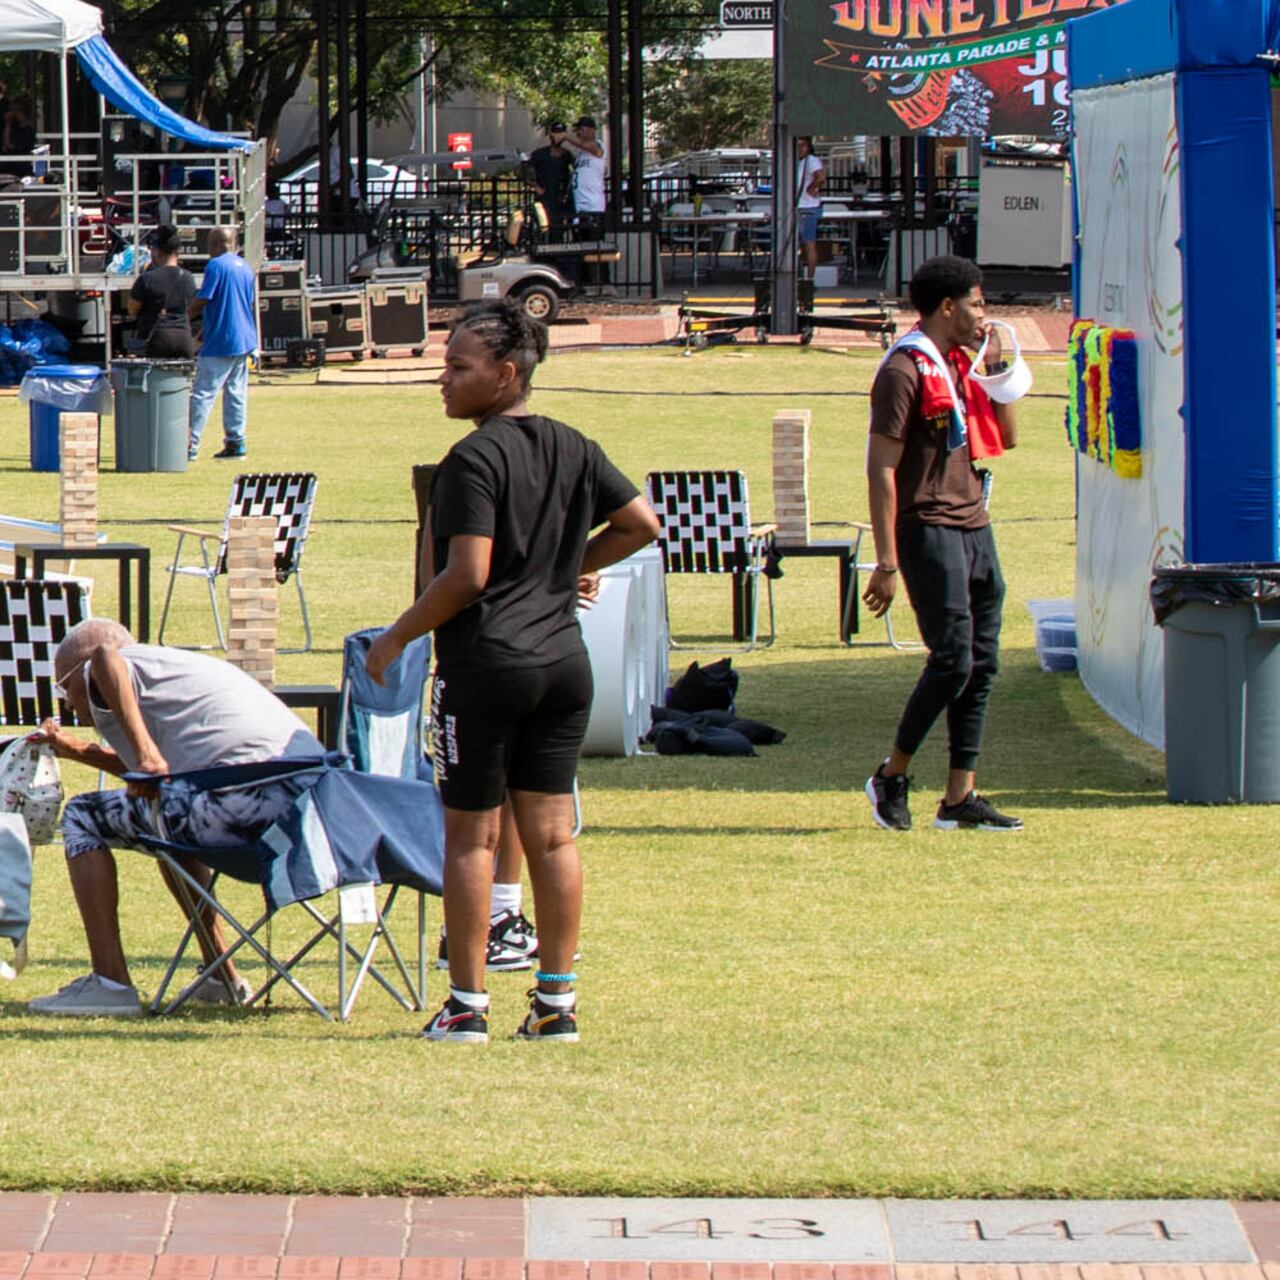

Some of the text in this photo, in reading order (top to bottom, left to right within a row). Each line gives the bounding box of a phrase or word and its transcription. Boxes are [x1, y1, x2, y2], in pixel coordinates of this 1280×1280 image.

[725, 7, 771, 20] NORTH
[866, 51, 951, 69] ATLANTA
[957, 36, 1030, 62] PARADE
[1035, 31, 1049, 46] &
[1004, 196, 1039, 211] EDLEN
[587, 1217, 826, 1239] 143
[942, 1219, 1193, 1240] 144
